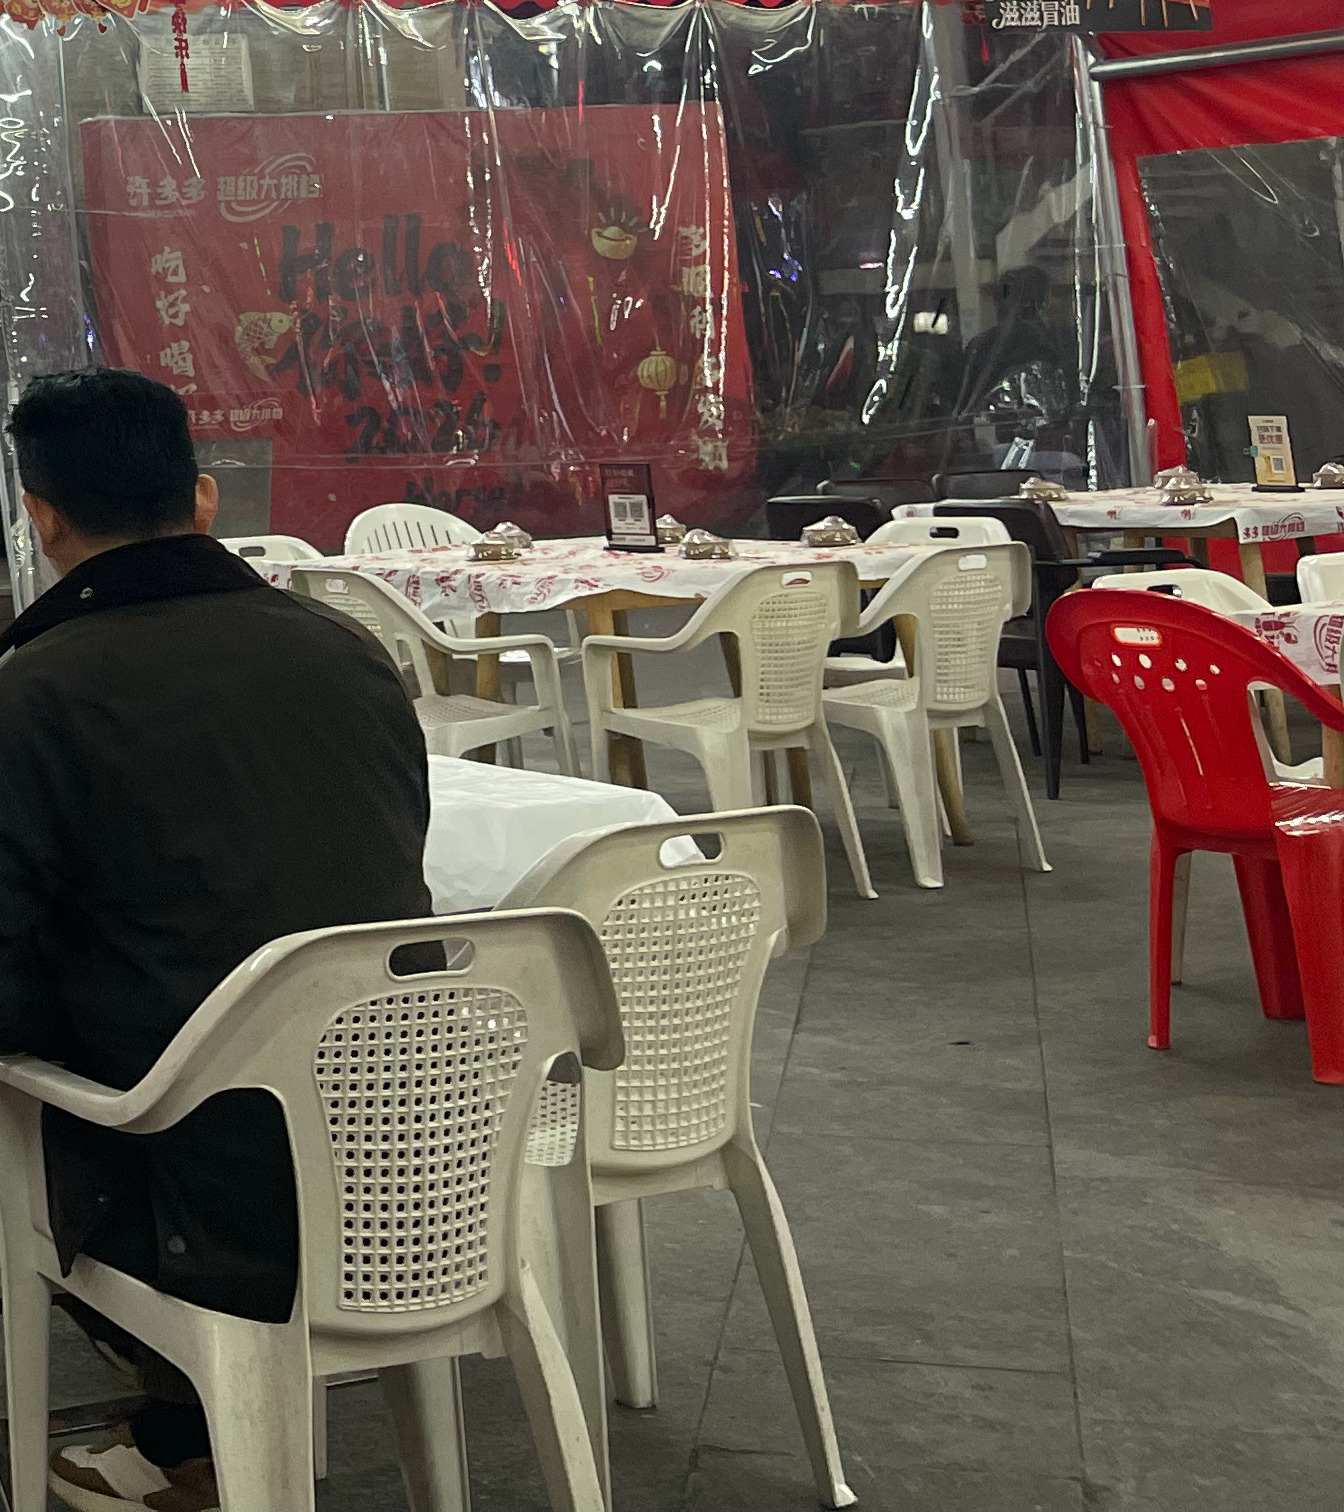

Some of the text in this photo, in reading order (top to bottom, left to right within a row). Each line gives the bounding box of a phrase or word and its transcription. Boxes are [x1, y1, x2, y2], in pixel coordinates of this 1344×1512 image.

[992, 0, 1080, 31] 滋滋冒油
[127, 175, 206, 206] 许多多
[279, 213, 473, 303] Hello
